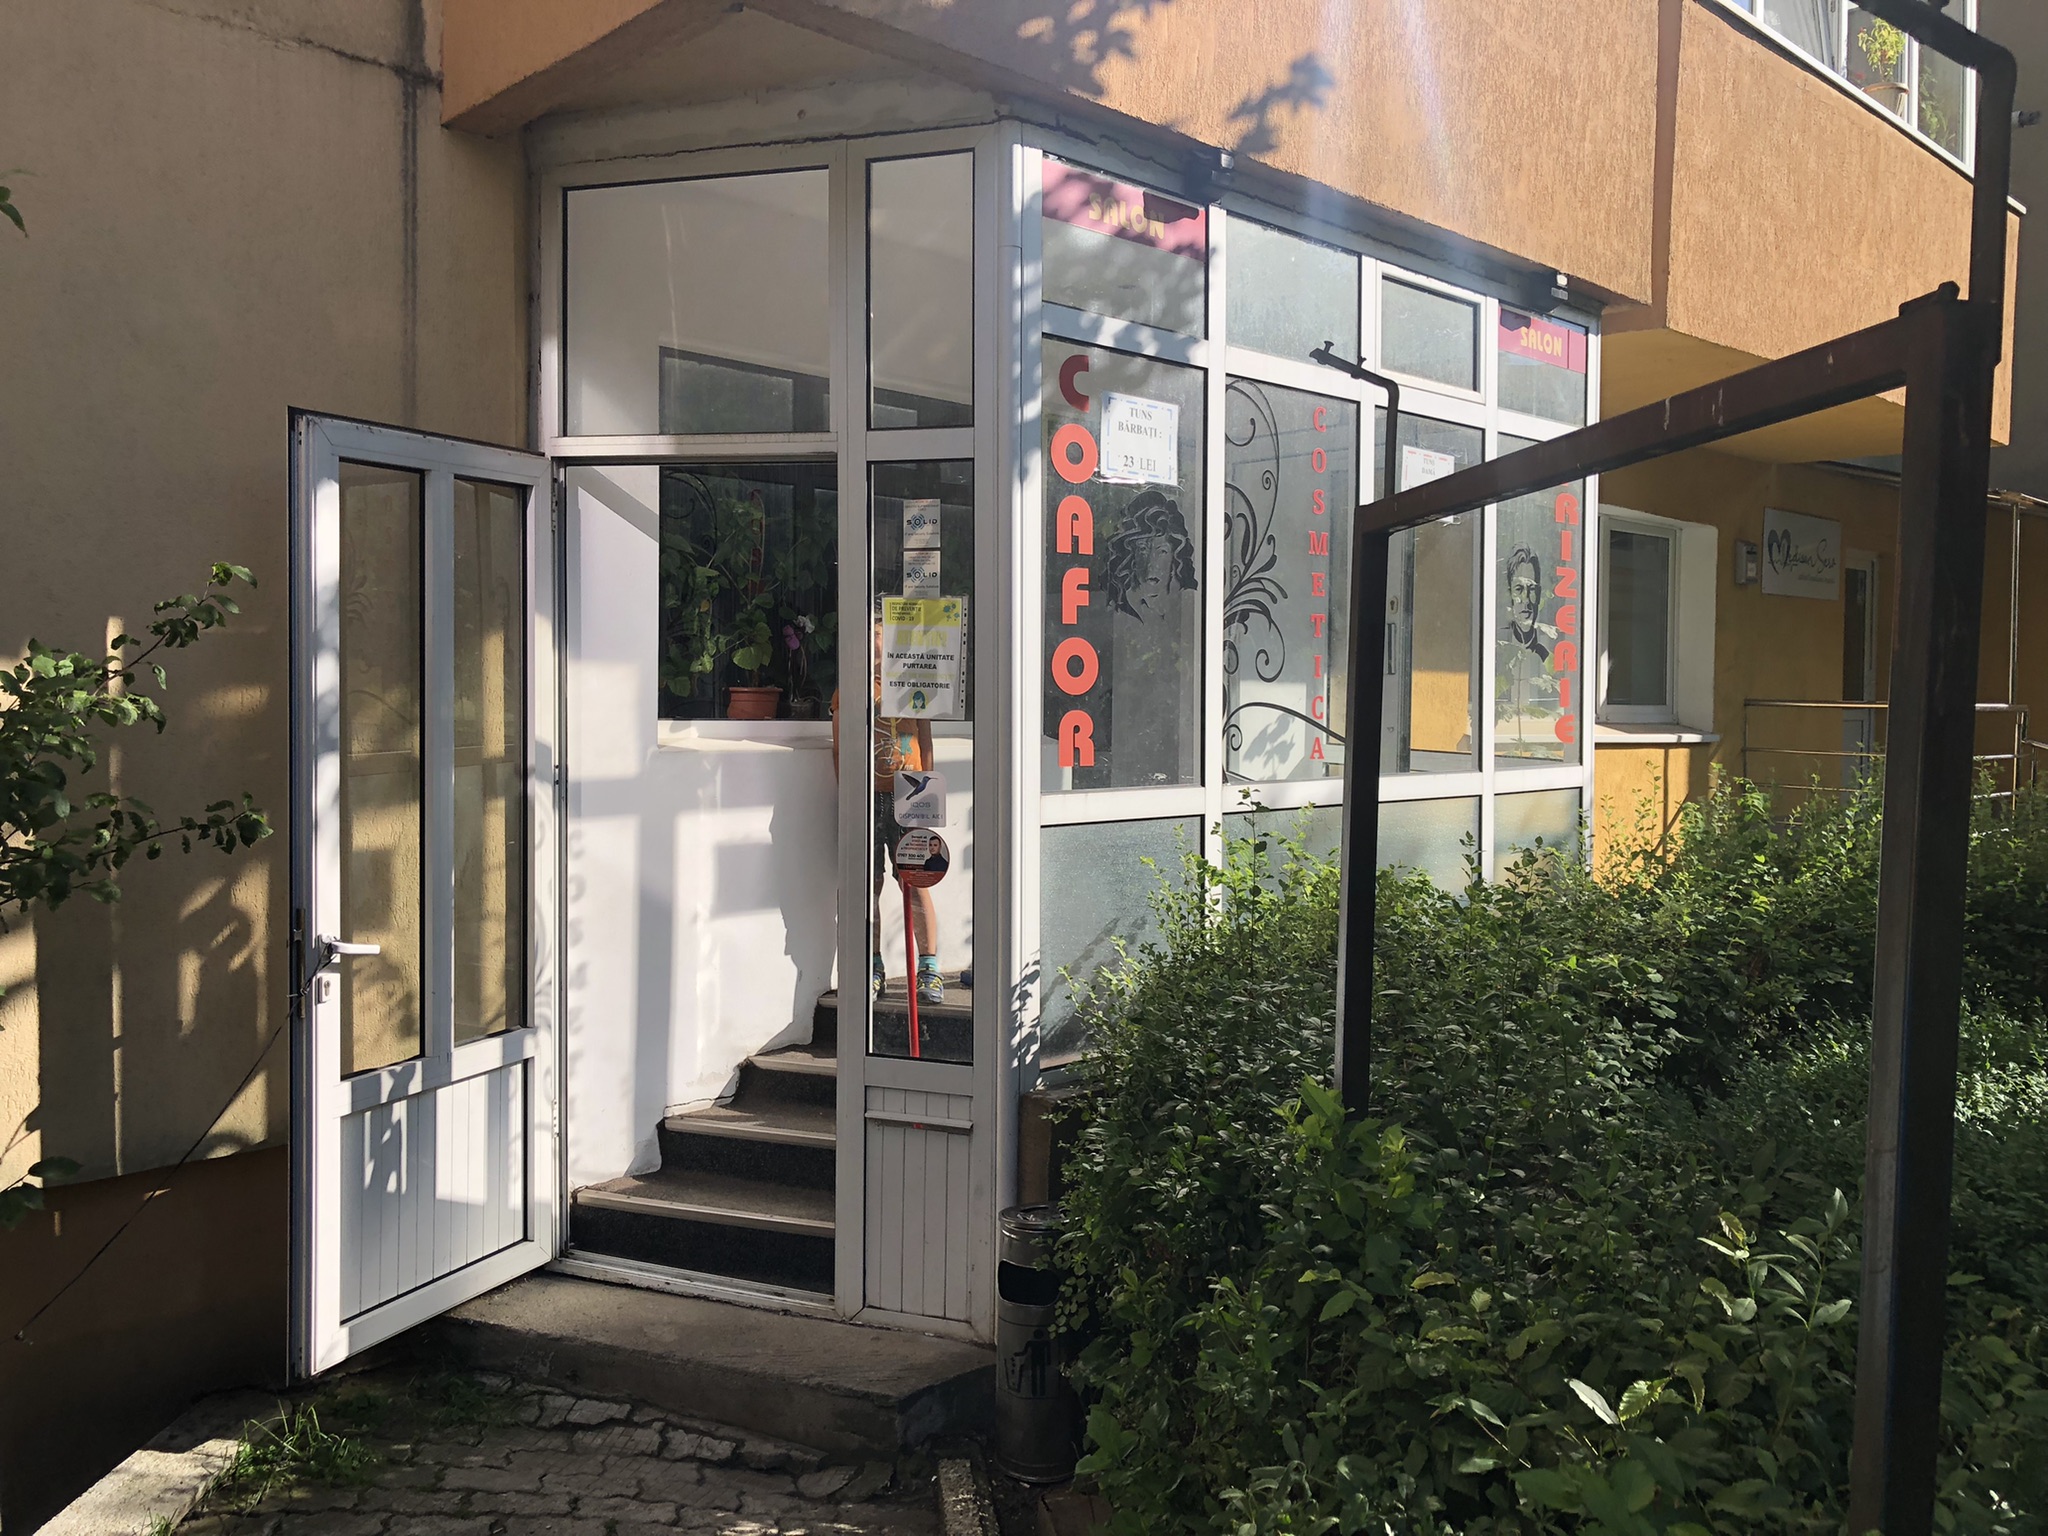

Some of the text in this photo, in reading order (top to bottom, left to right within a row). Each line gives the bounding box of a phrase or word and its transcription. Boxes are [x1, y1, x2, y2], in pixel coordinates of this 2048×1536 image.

[1088, 192, 1165, 240] SALON
[1520, 326, 1563, 358] SALON
[1129, 407, 1153, 421] TUNS
[1123, 454, 1156, 472] 23 LEI
[906, 518, 938, 526] SOLID
[1050, 354, 1099, 768] COAFOR
[906, 571, 938, 579] SOLID
[1308, 406, 1329, 760] COSMETICA
[1553, 482, 1579, 745] RIZERIE
[926, 653, 955, 661] UNITATE
